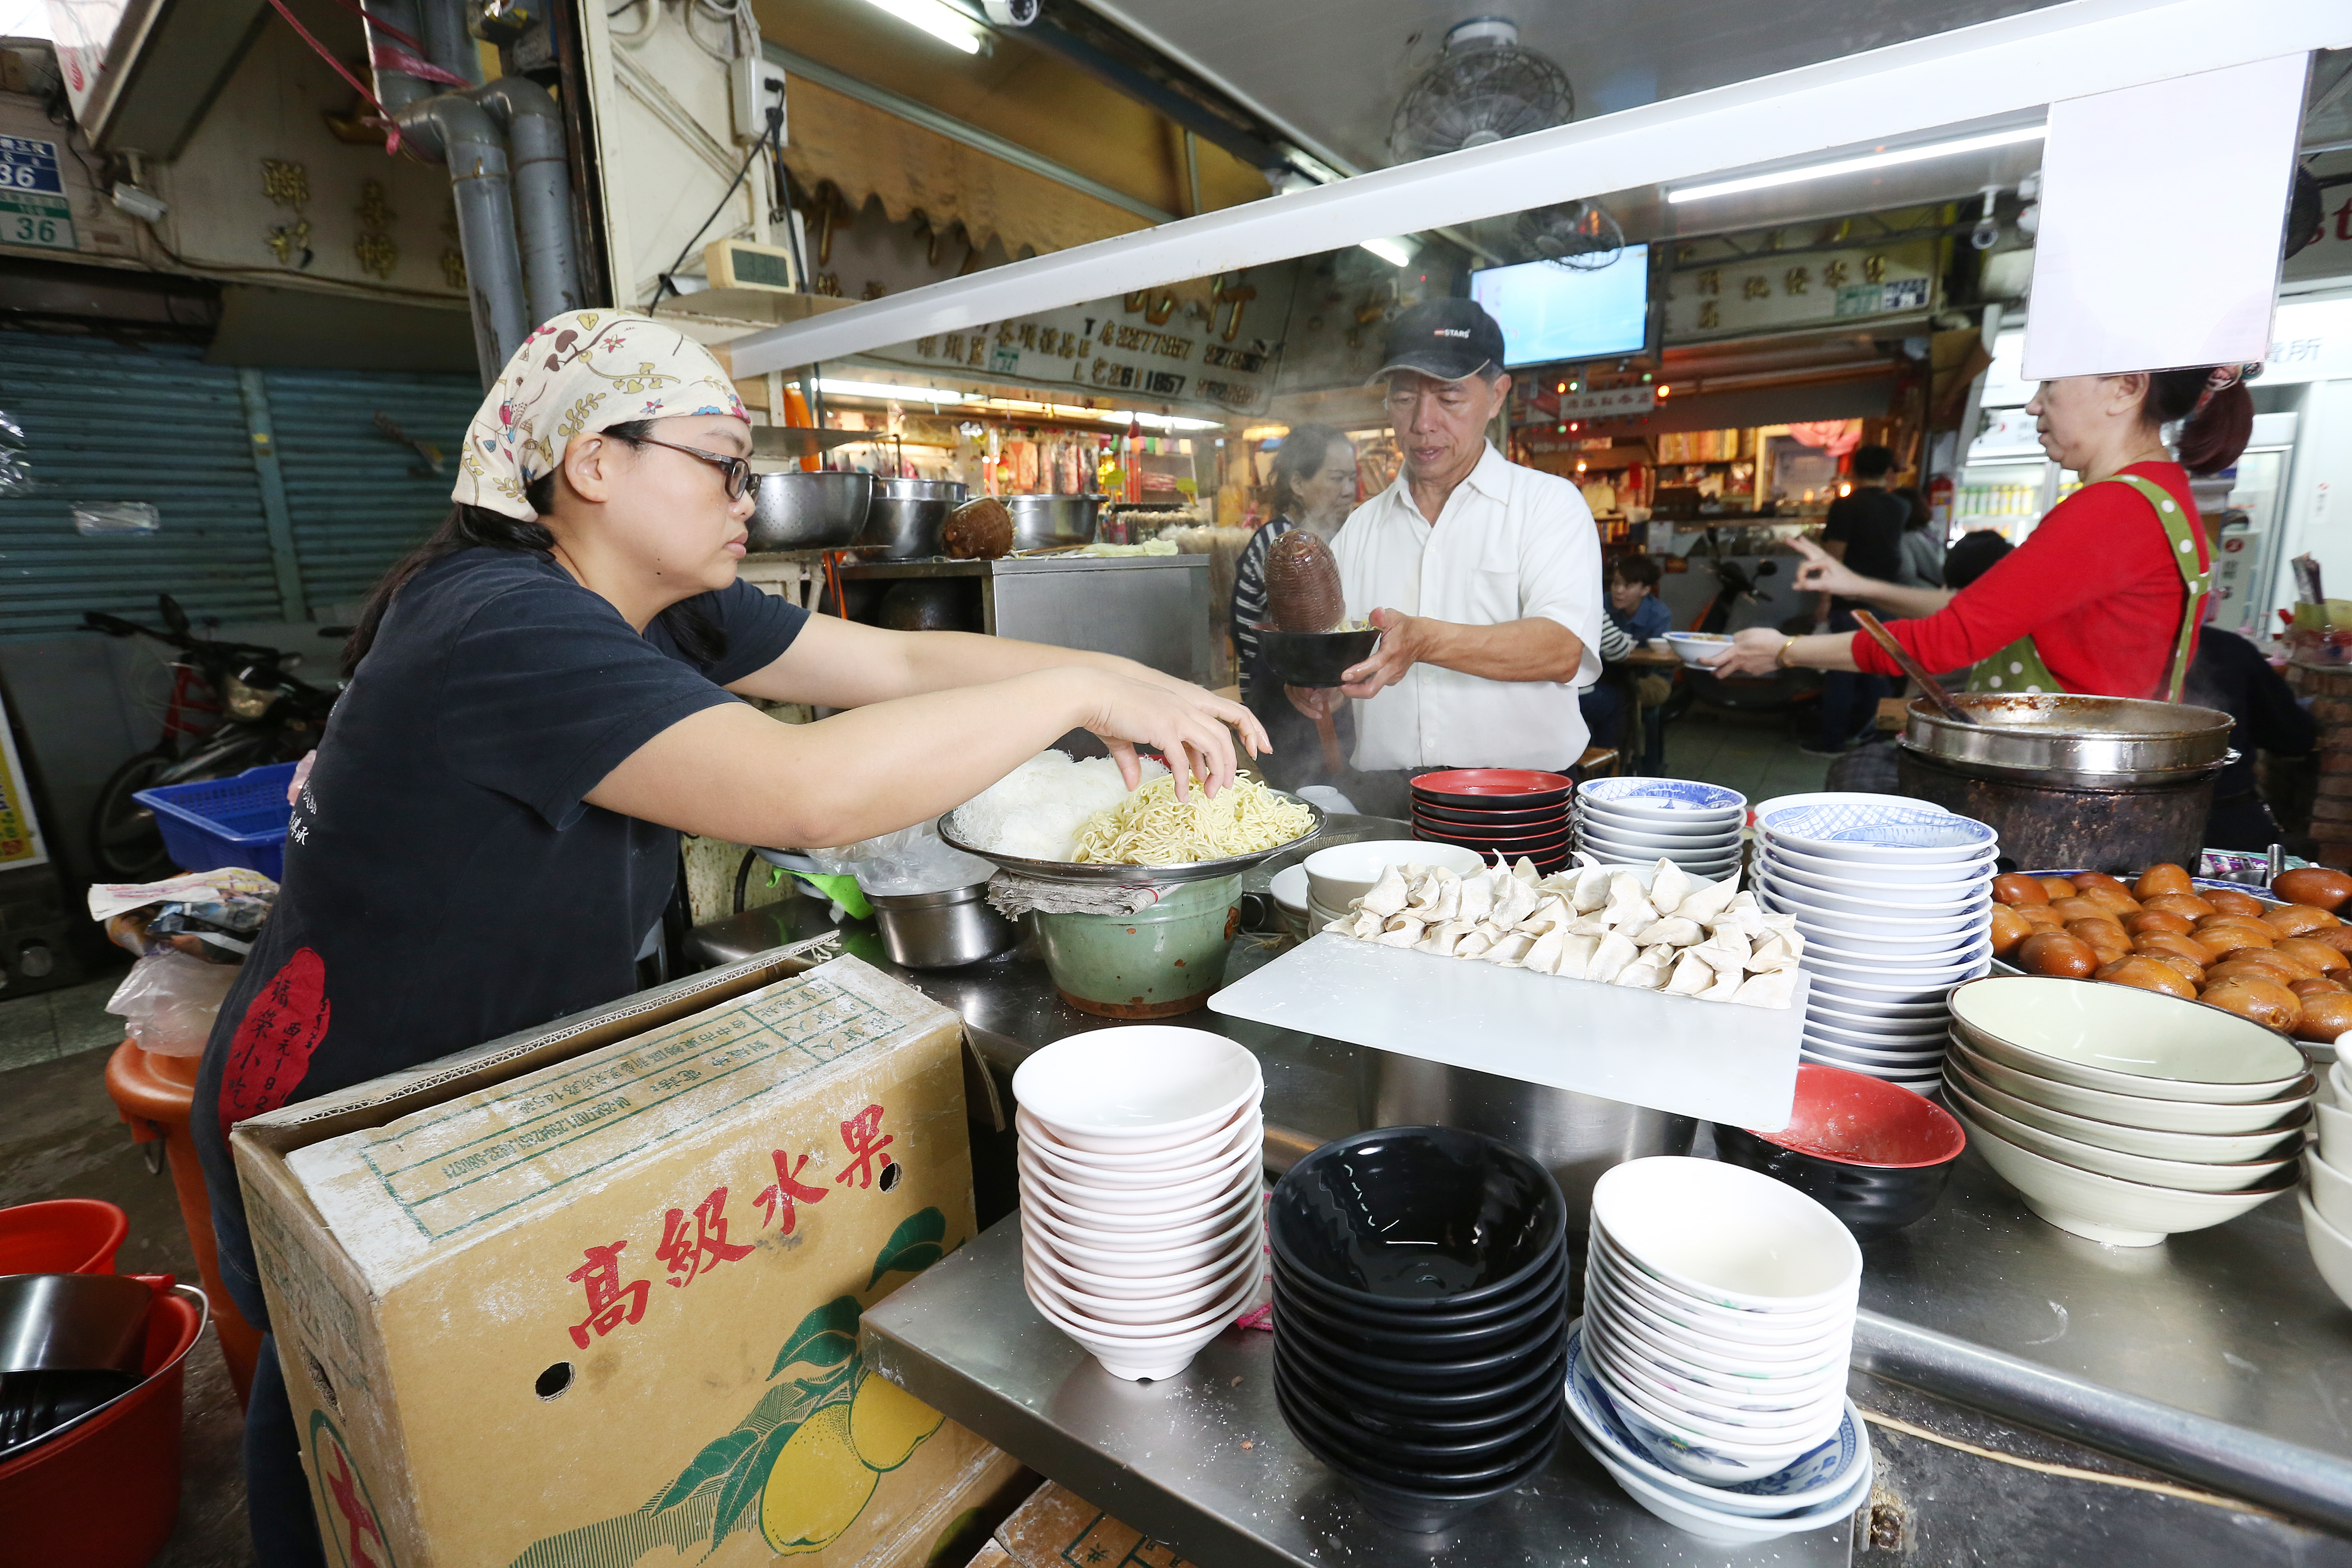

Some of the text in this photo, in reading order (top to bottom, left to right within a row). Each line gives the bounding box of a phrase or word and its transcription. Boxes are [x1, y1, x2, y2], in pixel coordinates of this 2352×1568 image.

[0, 163, 36, 188] 36
[16, 217, 56, 243] 36
[567, 1105, 893, 1349] 高級水果
